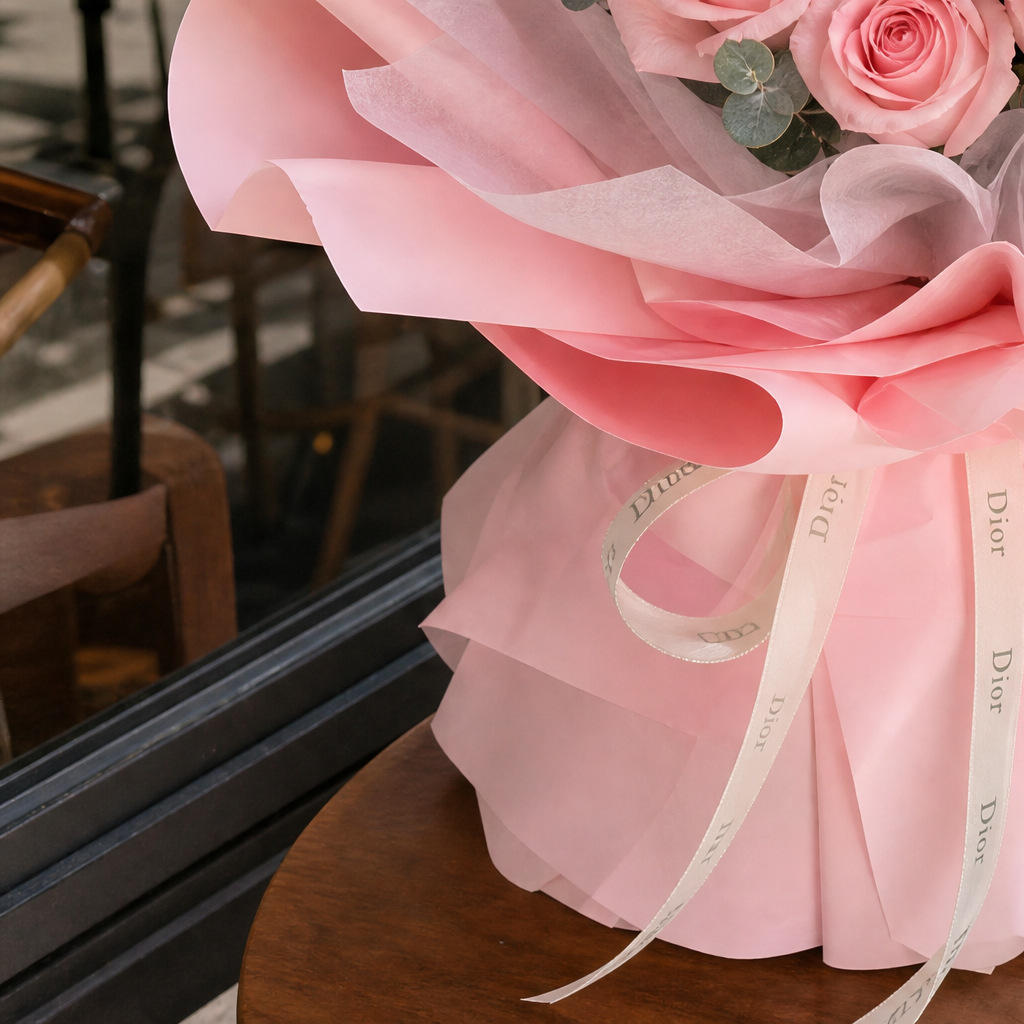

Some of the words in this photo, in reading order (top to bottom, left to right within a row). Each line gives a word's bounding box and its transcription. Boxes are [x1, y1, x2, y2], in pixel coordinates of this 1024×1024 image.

[987, 489, 1009, 557] Dior
[990, 647, 1013, 714] Dior
[754, 693, 786, 752] Dior
[974, 796, 998, 867] Dior
